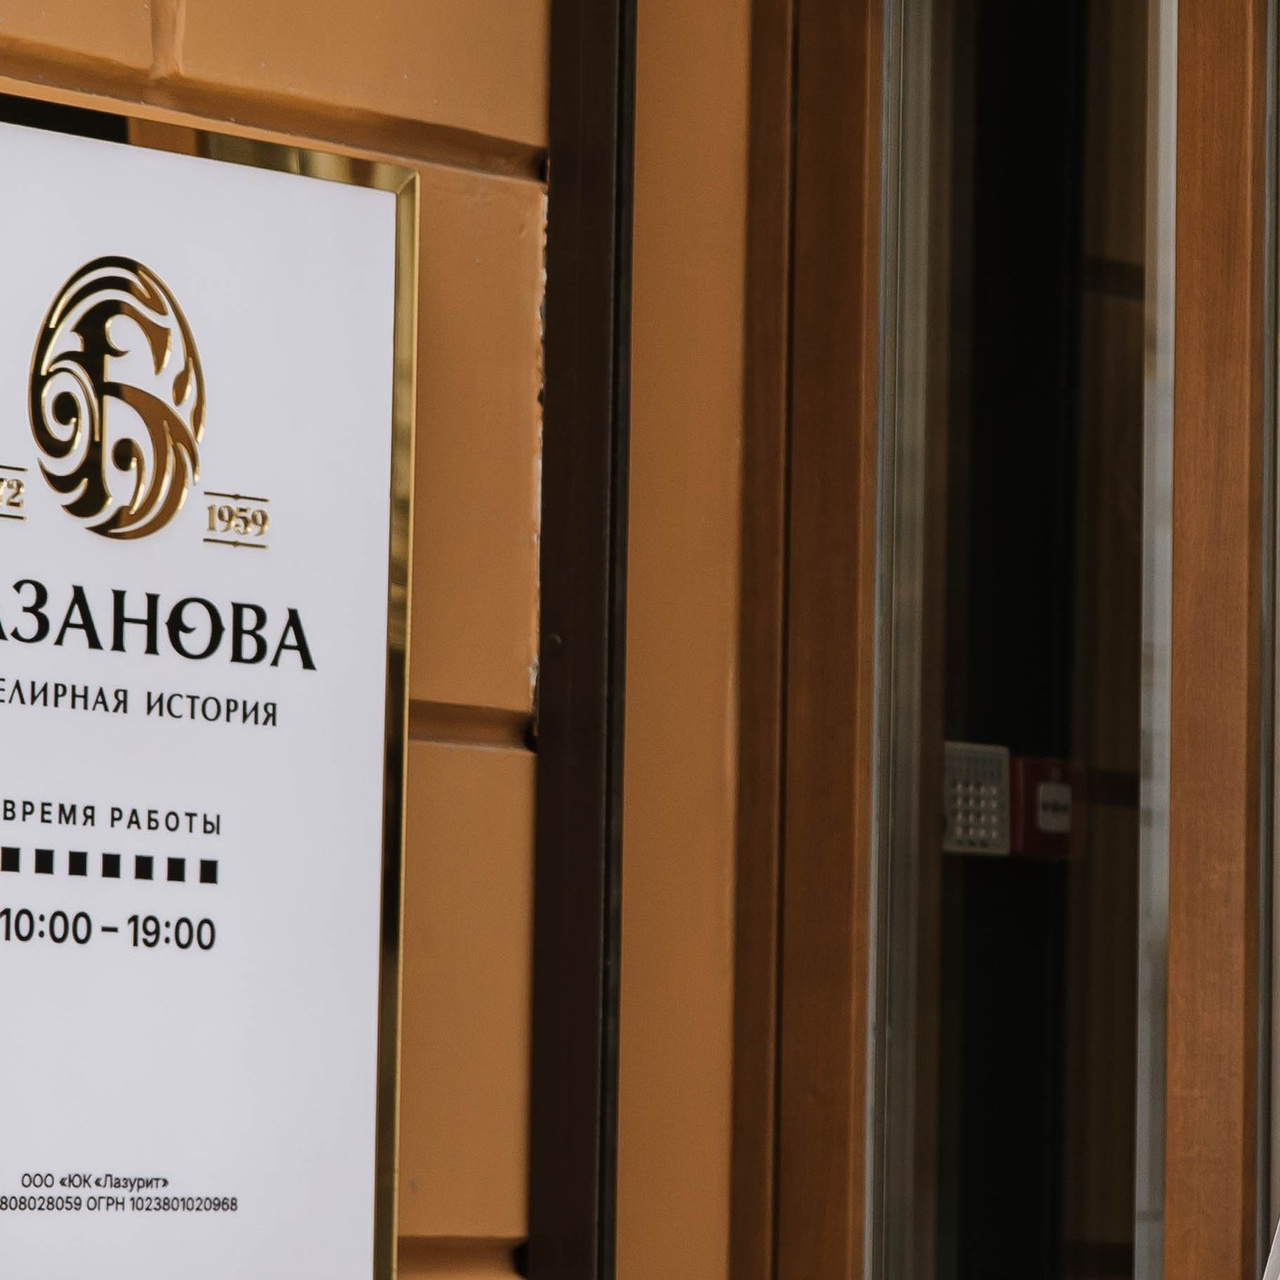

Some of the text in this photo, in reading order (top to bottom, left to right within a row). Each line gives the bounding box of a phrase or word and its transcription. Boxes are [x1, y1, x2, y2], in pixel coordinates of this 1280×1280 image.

[207, 504, 269, 536] 1959
[0, 578, 317, 671] ЗАНОВА
[146, 691, 278, 727] ИСТОРИЯ
[3, 799, 221, 835] ВРЕМЯ РАБОТЫ
[0, 907, 93, 945] 10:00
[127, 914, 216, 951] 19:00
[21, 1173, 169, 1192] ООО «ЮК «Лазурит»
[86, 1195, 126, 1211] ОГРН
[129, 1196, 238, 1212] 1023801020968
